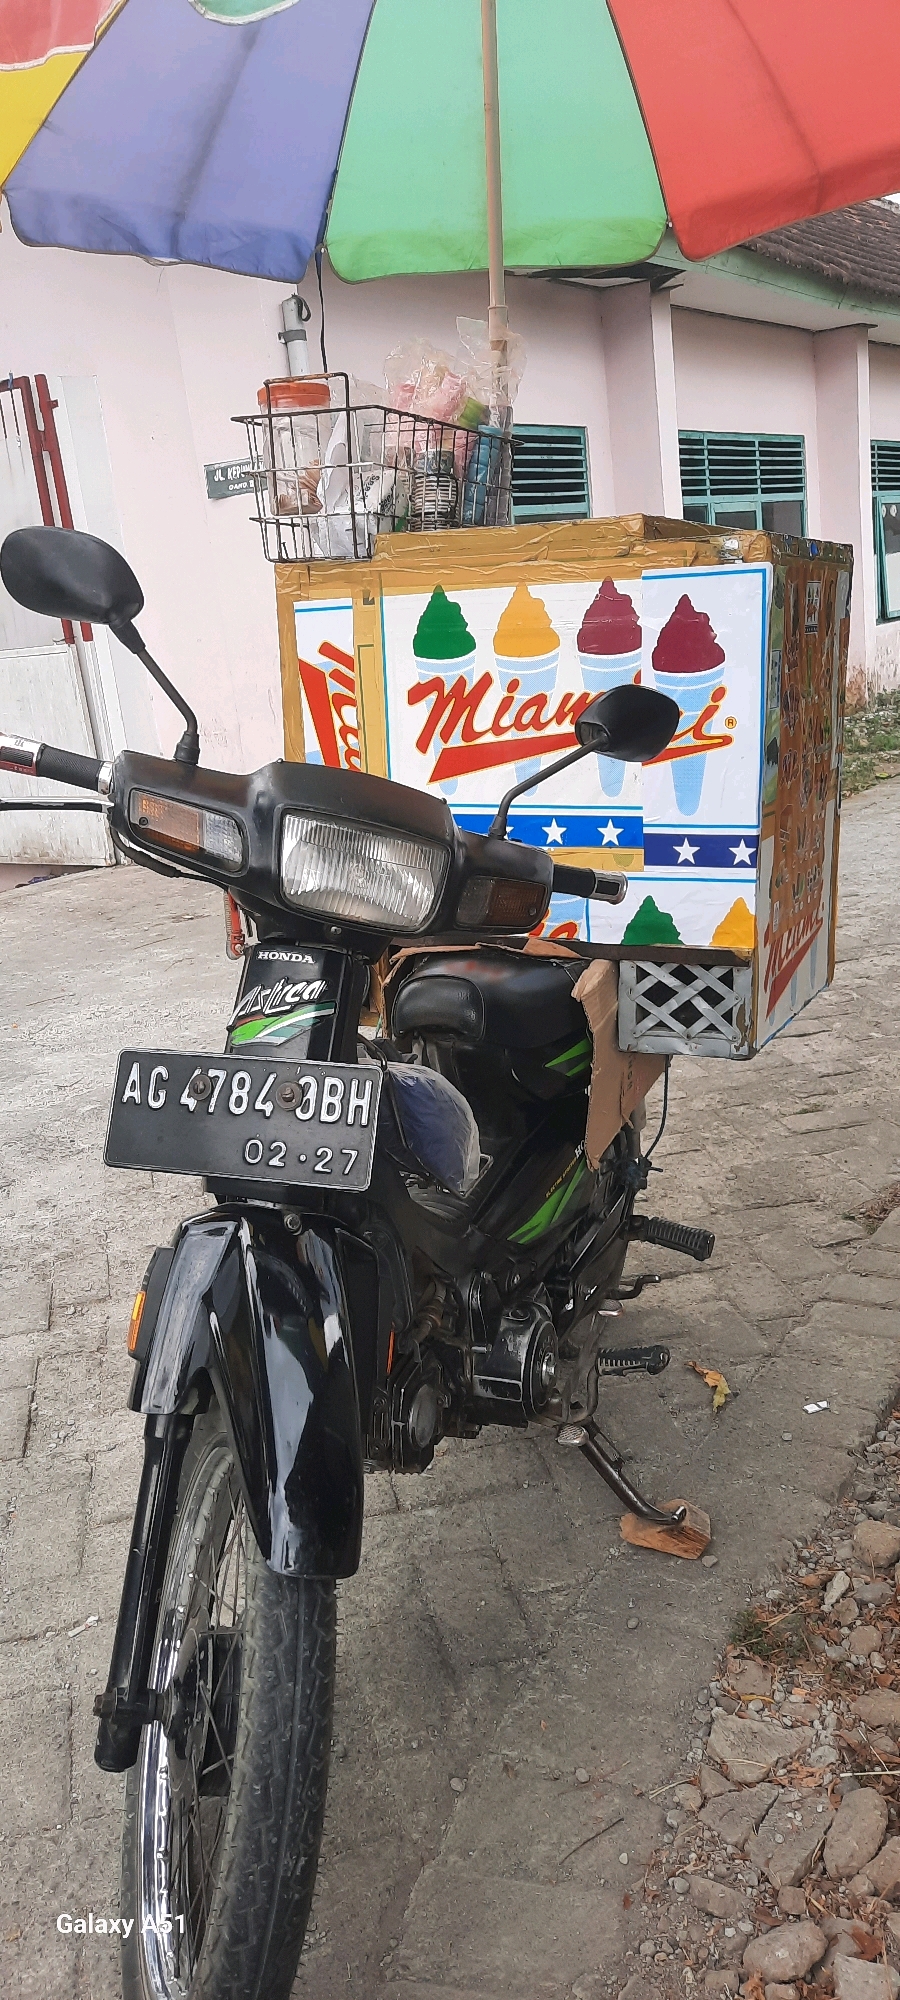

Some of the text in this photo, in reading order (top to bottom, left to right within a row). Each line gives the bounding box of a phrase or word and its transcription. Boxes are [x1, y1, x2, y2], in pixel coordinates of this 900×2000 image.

[257, 951, 315, 964] HONDA
[121, 1062, 169, 1110] AG
[180, 1066, 278, 1118] 4784
